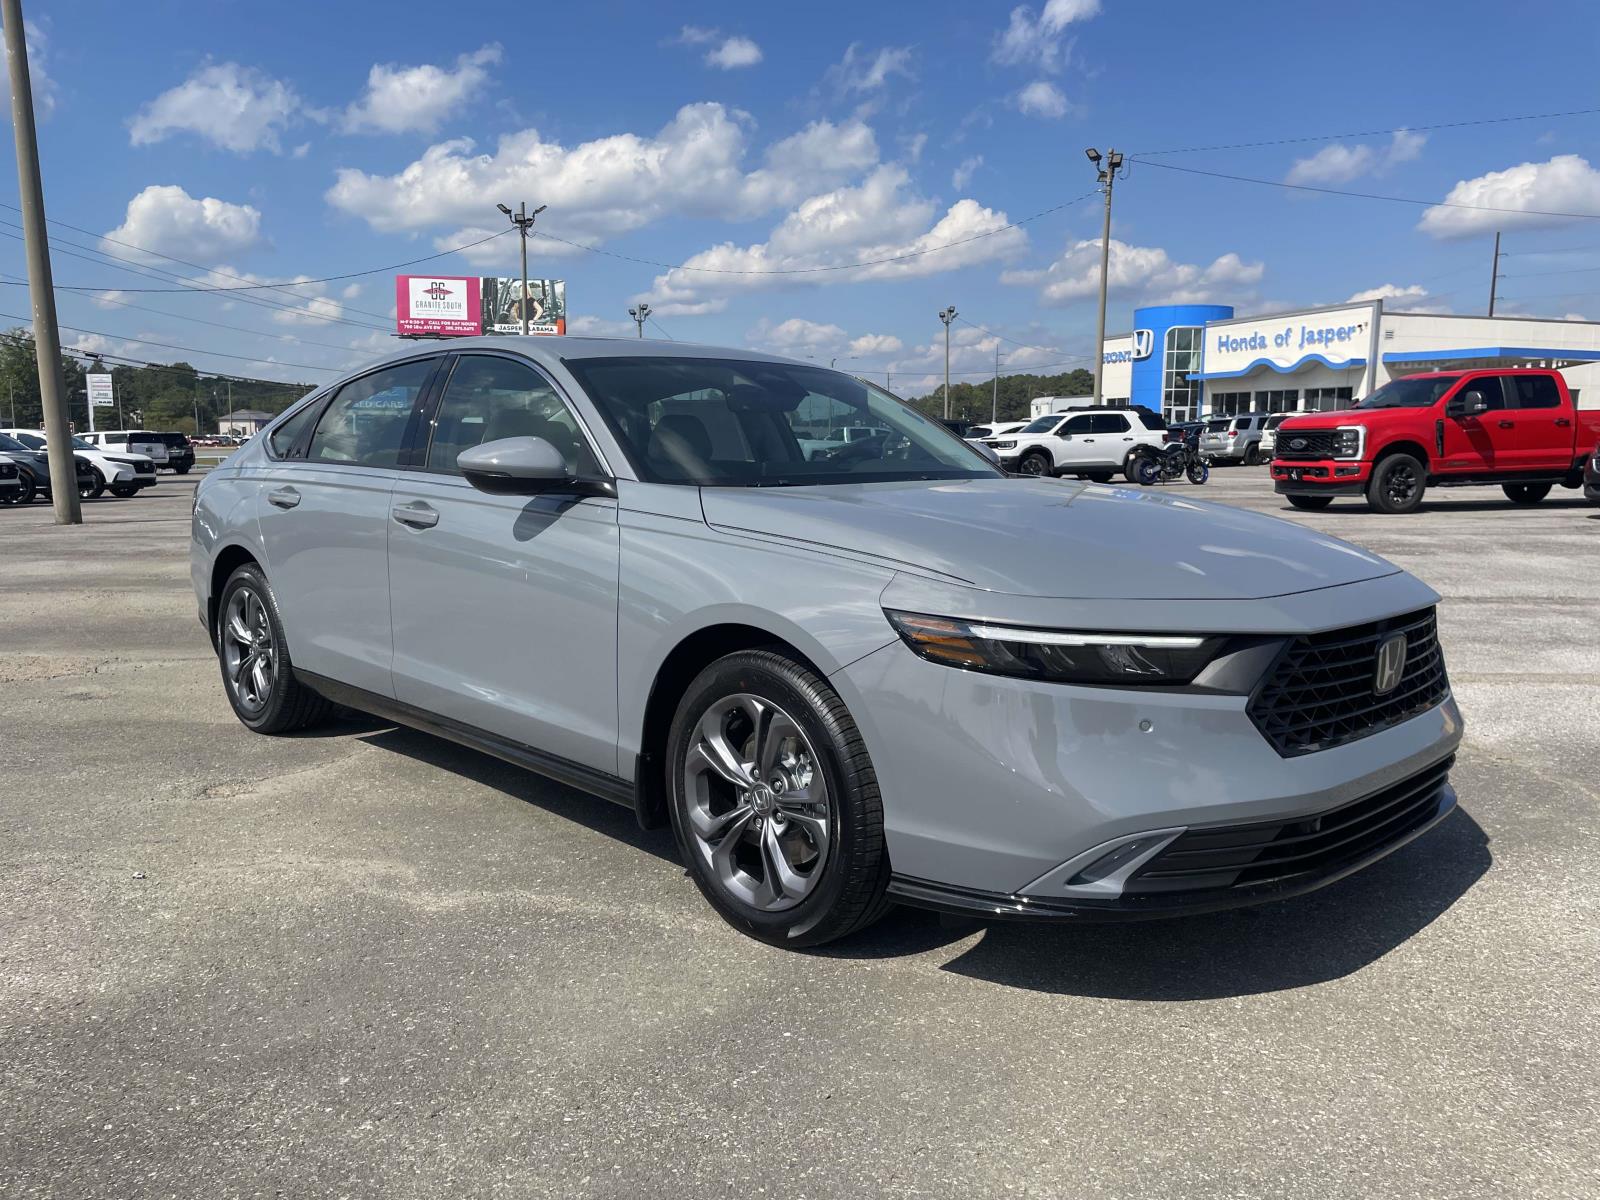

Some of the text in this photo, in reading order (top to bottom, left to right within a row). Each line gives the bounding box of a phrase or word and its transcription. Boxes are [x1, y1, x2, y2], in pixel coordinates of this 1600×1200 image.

[415, 300, 462, 310] GRANITE SOUTH
[1217, 322, 1357, 354] Honda of Jasper
